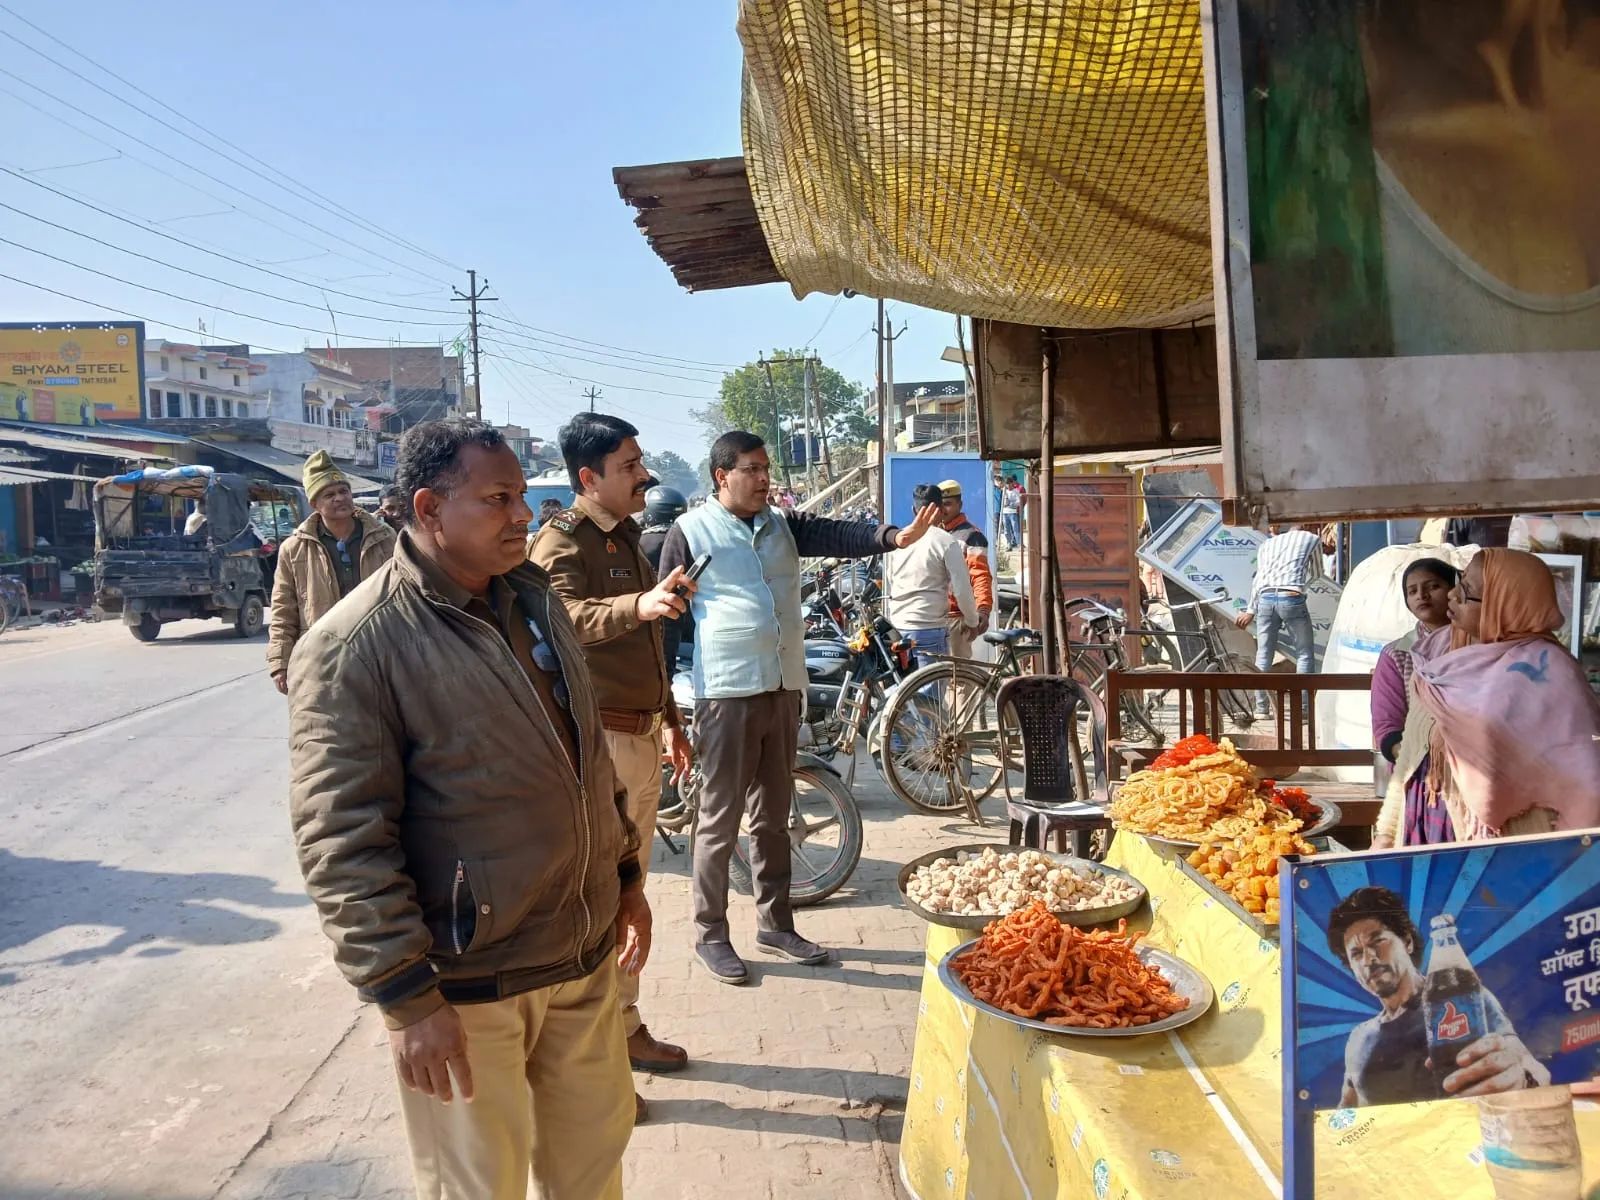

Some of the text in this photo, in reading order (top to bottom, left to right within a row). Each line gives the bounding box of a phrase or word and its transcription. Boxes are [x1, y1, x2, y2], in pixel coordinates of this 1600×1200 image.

[12, 364, 129, 375] SHYAM STEEL
[1202, 538, 1257, 546] ANEXA
